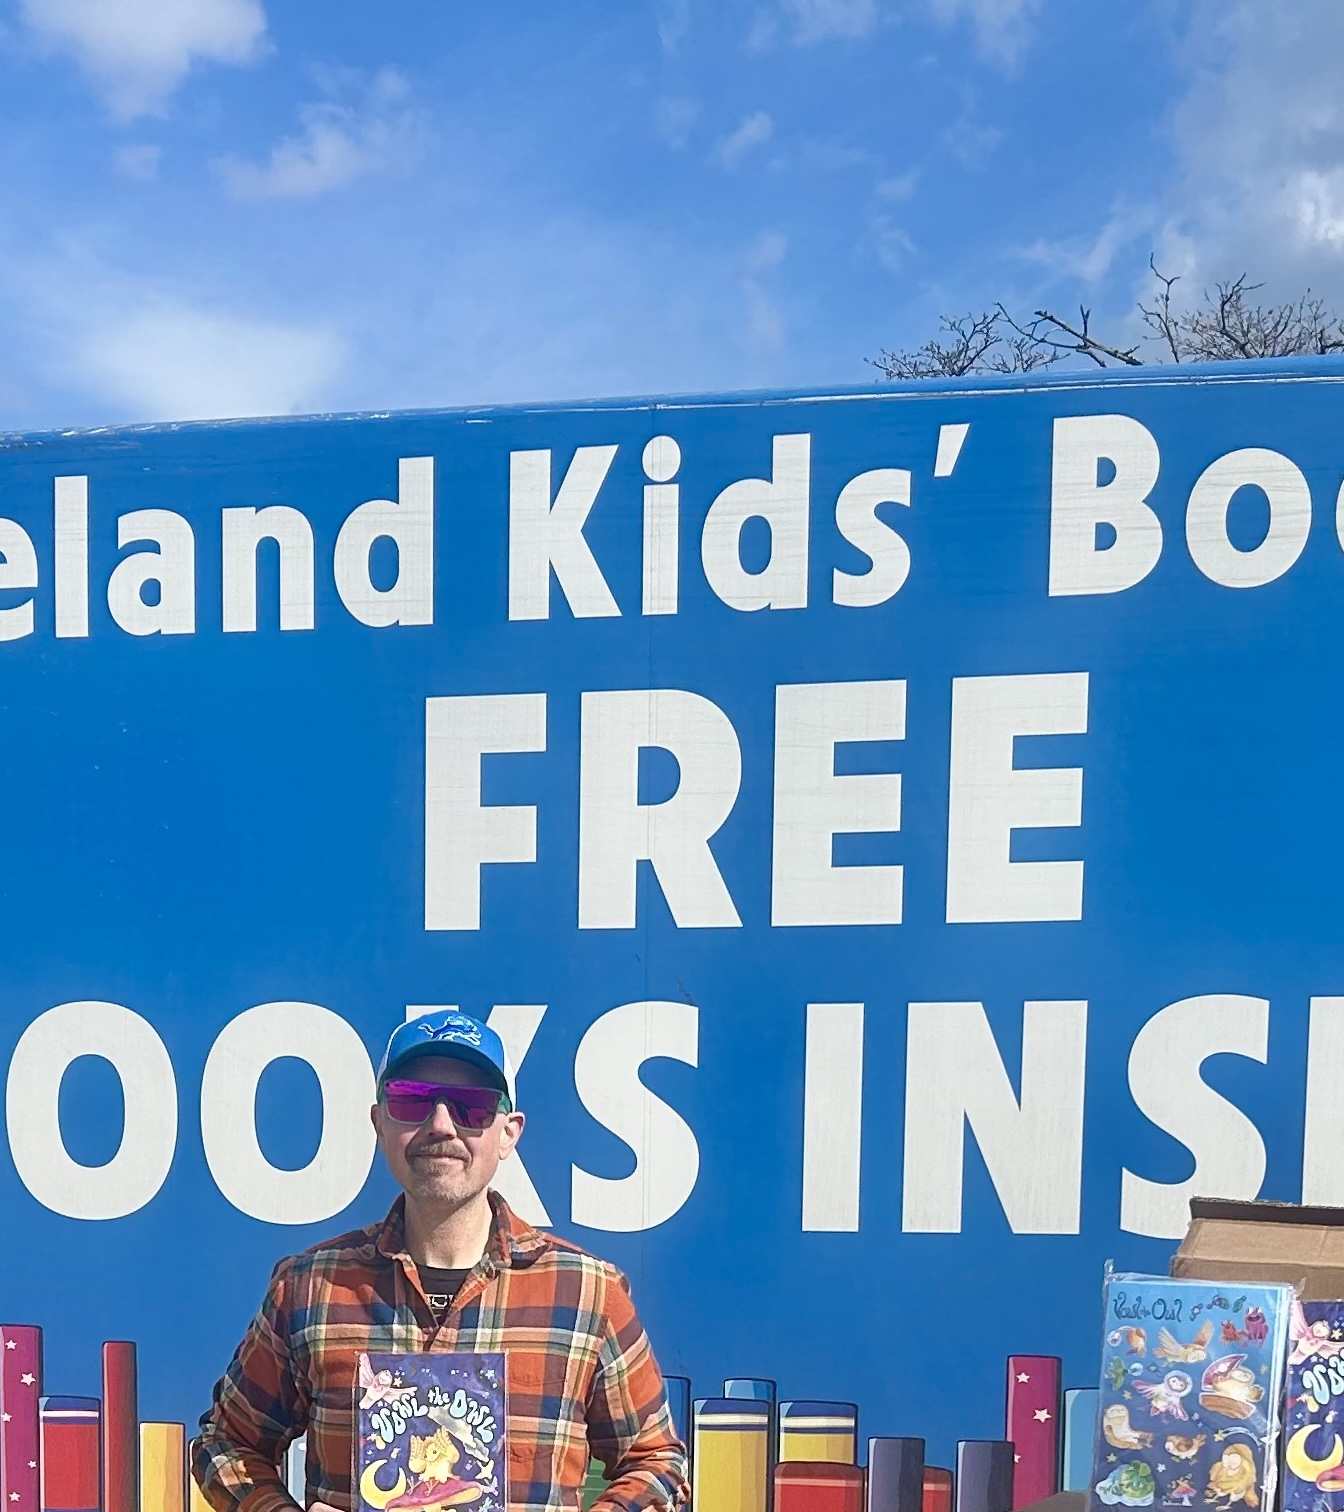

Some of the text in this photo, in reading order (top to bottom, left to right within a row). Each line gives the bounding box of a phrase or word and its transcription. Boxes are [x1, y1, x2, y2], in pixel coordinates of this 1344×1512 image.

[425, 673, 1088, 930] FREE
[371, 1387, 495, 1443] VOWL the OWL
